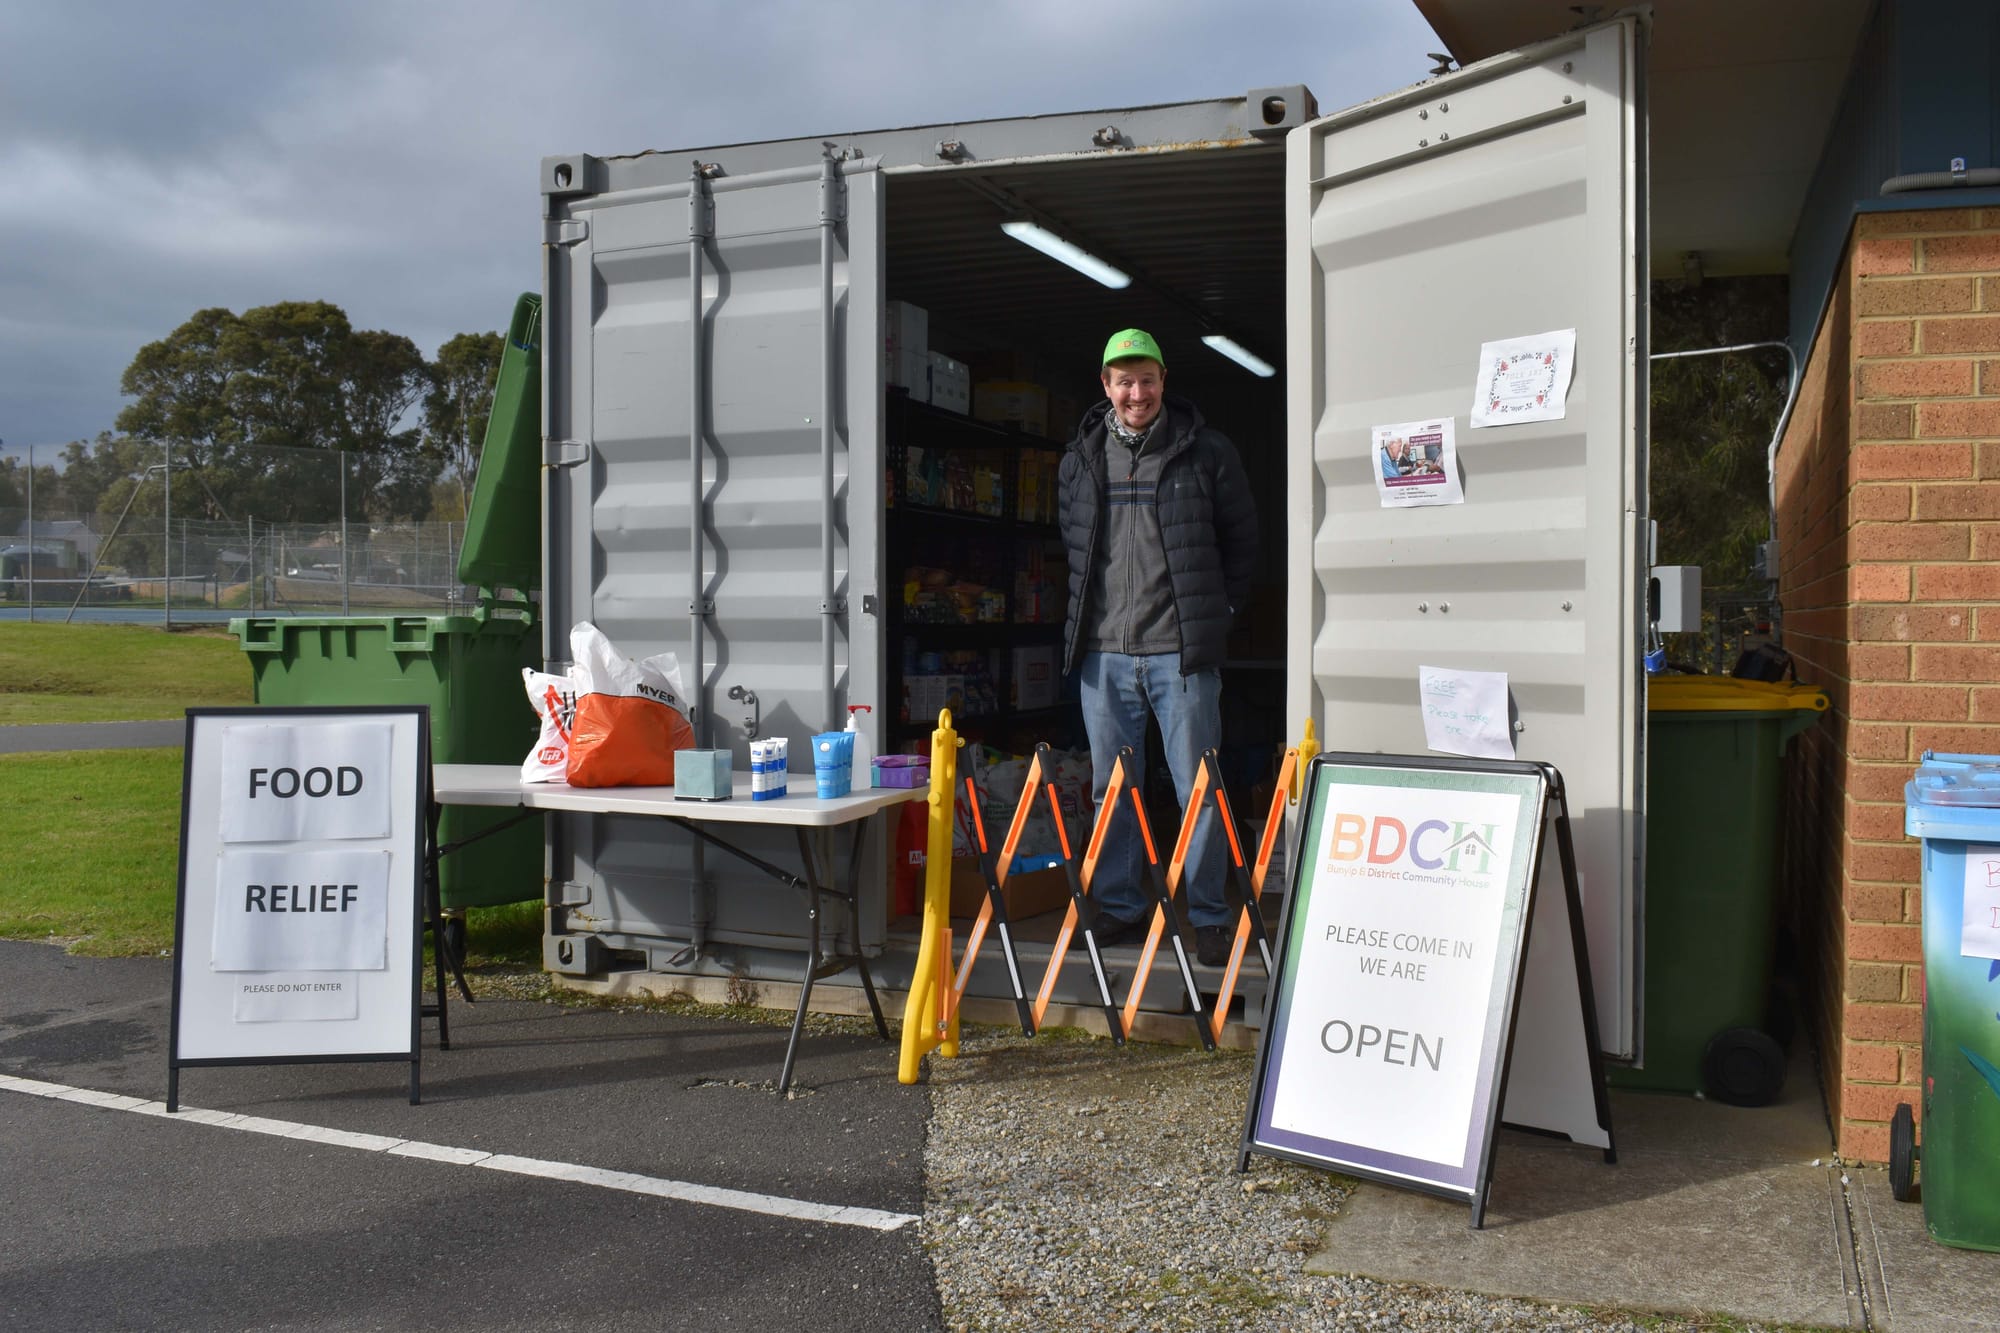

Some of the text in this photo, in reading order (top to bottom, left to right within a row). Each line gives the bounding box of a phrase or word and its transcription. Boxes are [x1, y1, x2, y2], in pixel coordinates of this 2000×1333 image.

[636, 683, 676, 705] MYER
[1426, 675, 1456, 691] FREE
[539, 749, 562, 761] IGA
[248, 765, 364, 799] FOOD
[1326, 863, 1358, 877] Bunyip
[1367, 867, 1401, 880] District
[1402, 871, 1457, 887] Community
[1458, 876, 1490, 889] House
[245, 884, 359, 913] RELIEF
[1325, 924, 1473, 960] PLEASE COME IN
[1360, 956, 1427, 982] WE ARE
[243, 983, 342, 993] PLEASE DO NOT ENTER
[1320, 1019, 1445, 1072] OPEN
